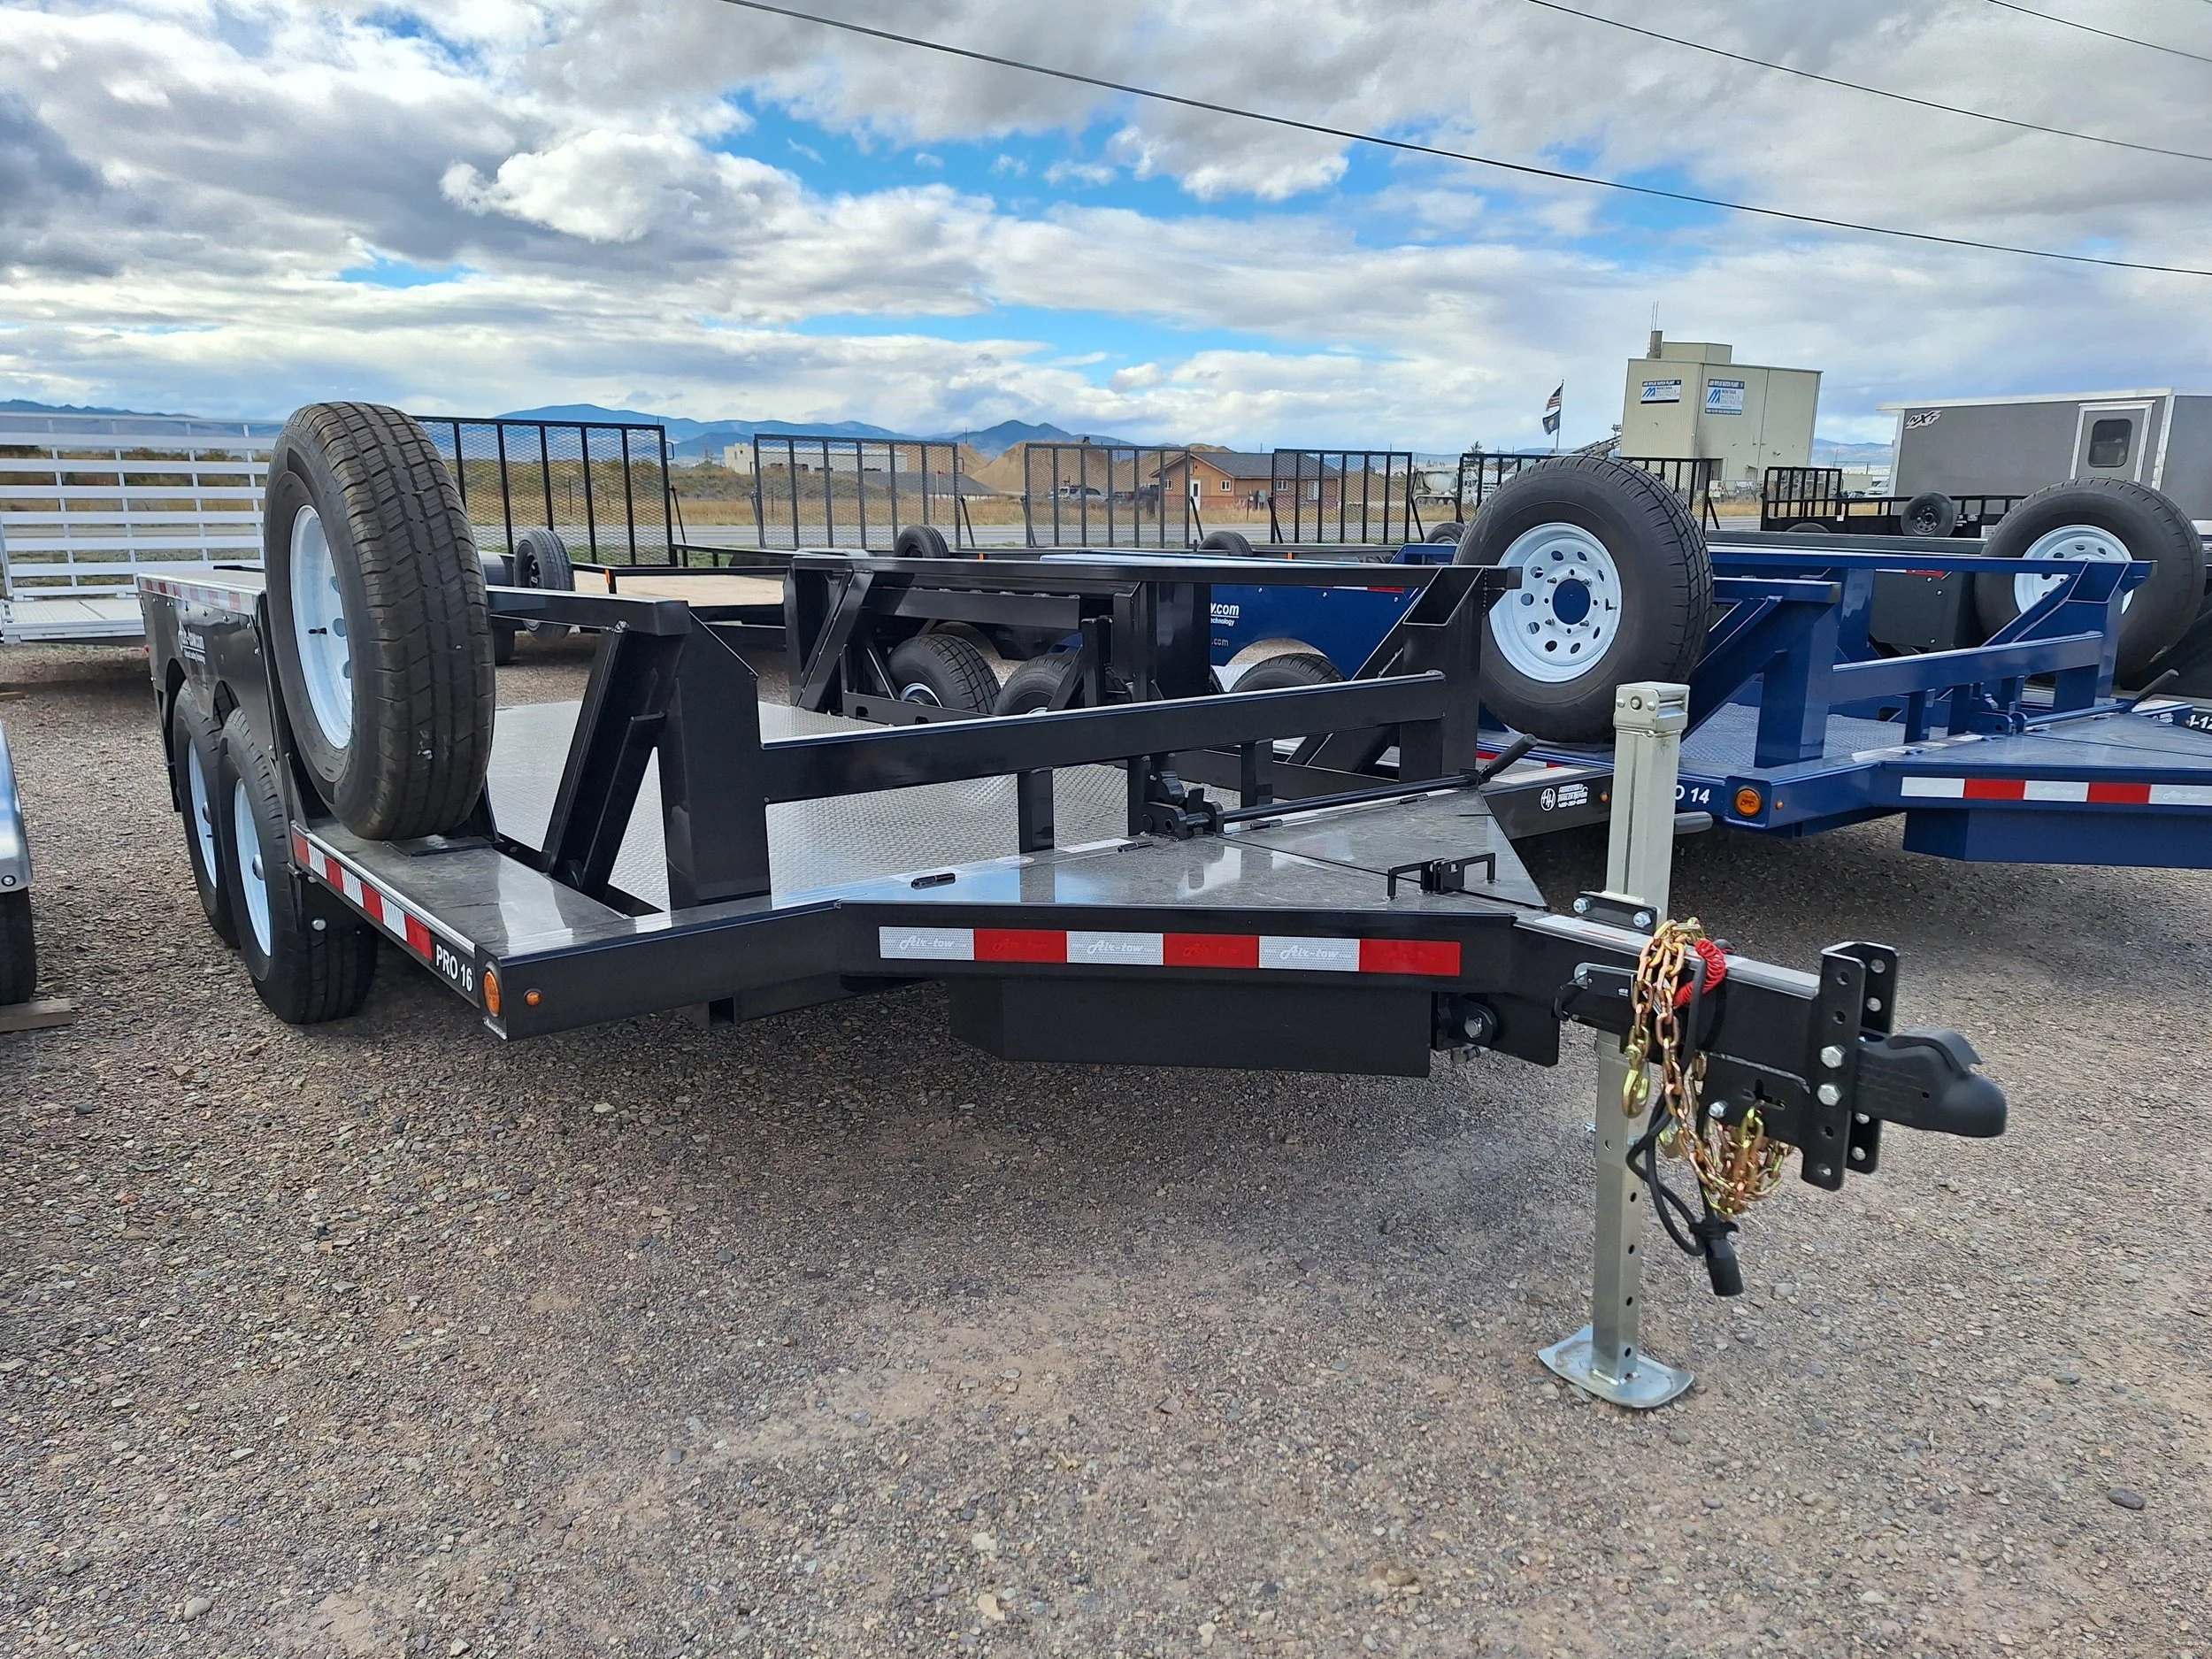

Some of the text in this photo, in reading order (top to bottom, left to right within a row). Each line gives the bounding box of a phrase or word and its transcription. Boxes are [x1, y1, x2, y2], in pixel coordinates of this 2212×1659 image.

[1908, 411, 1938, 427] NXT
[1211, 638, 1229, 647] .com
[1691, 787, 1710, 804] 14
[899, 935, 955, 950] Air-tow
[1087, 940, 1144, 955] Air-tow
[1280, 944, 1340, 960] Air-tow
[436, 943, 473, 992] PRO 16
